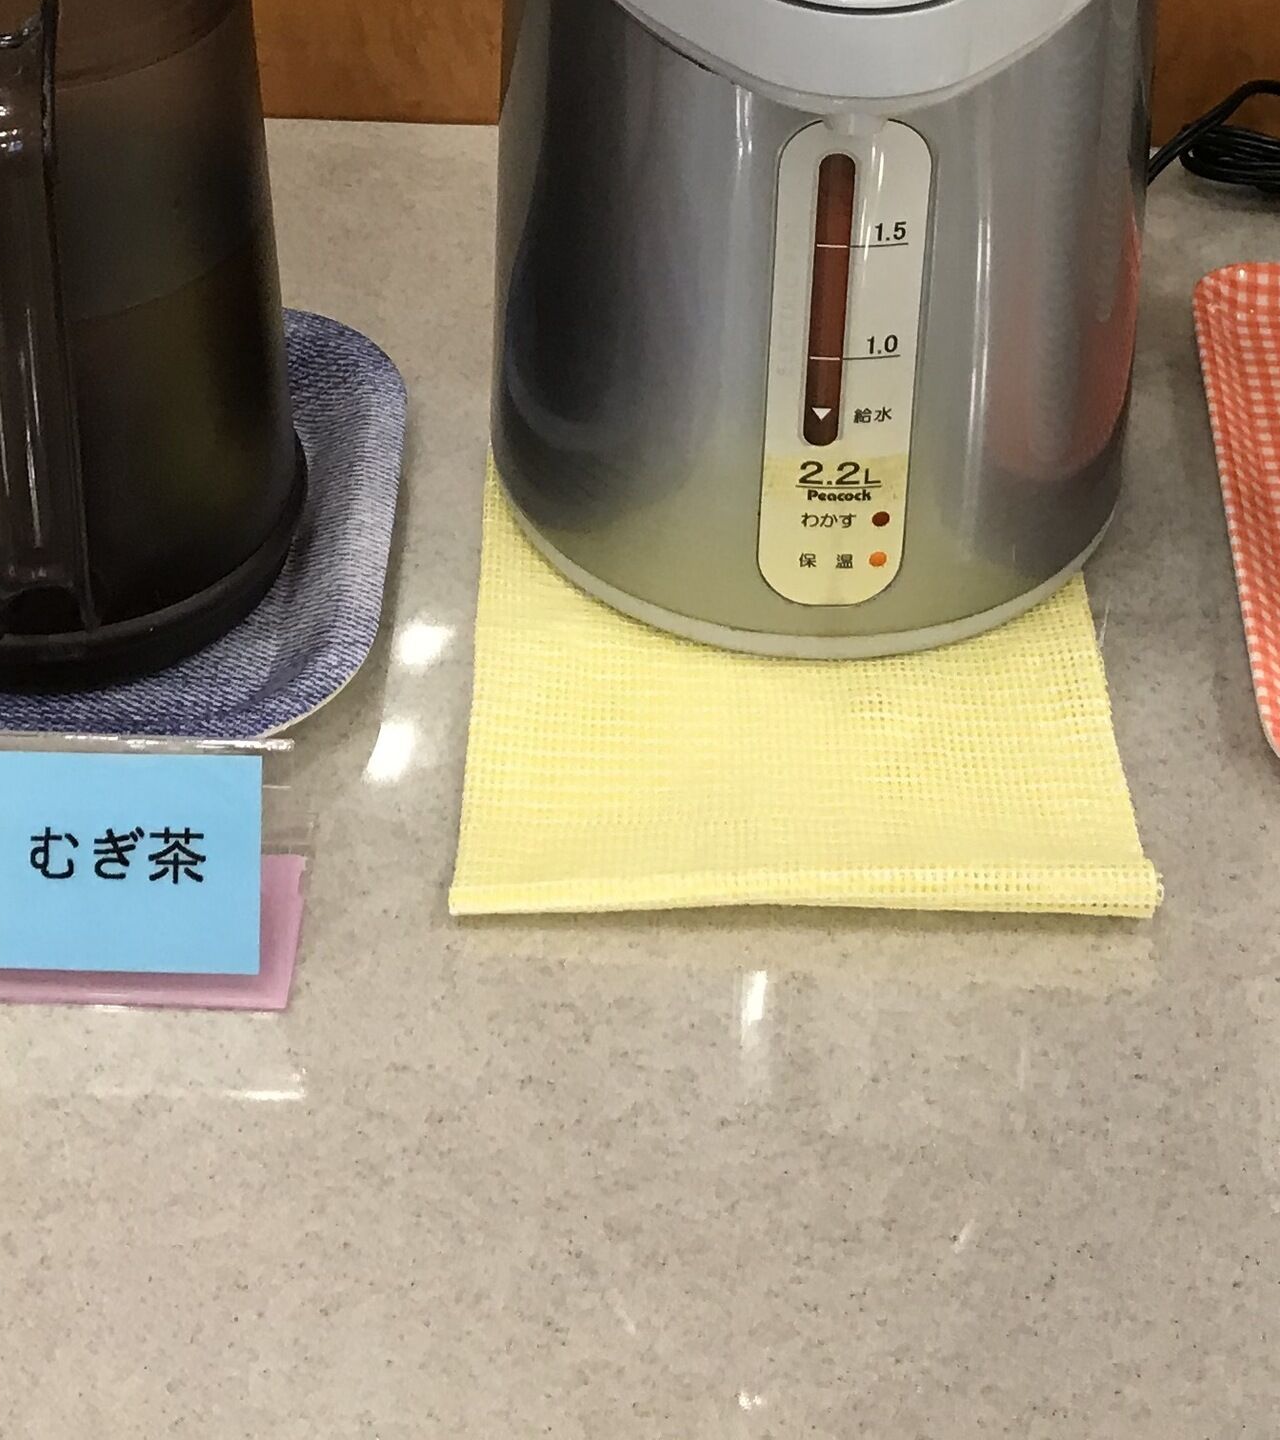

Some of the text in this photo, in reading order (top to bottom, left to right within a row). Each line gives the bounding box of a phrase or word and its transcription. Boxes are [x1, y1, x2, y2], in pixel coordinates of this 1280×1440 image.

[874, 221, 908, 243] 1.5
[865, 335, 899, 355] 1.0
[852, 406, 893, 426] 給水
[797, 460, 882, 486] 2.2L
[806, 488, 872, 503] Peacock
[800, 512, 857, 529] わかす
[28, 825, 207, 885] むぎ茶
